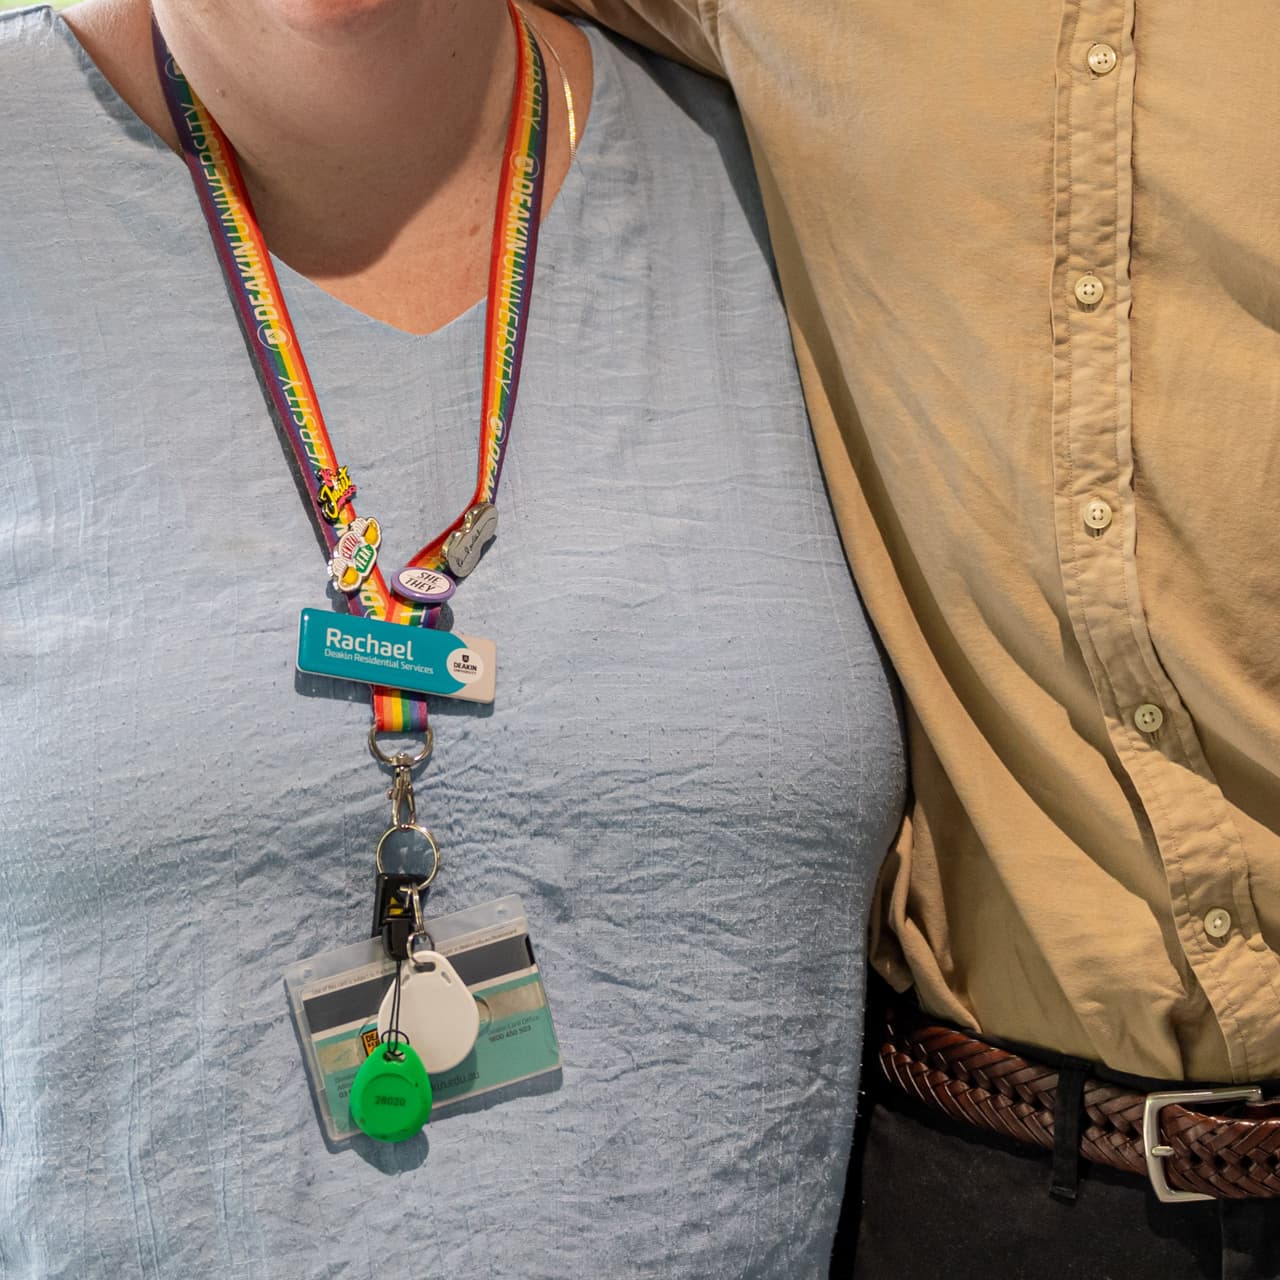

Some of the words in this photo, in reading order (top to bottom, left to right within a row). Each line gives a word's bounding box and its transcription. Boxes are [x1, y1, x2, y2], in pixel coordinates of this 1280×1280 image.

[180, 103, 250, 237] UNIVERSITY
[505, 174, 534, 255] DEAKIN
[230, 241, 279, 321] DEAKIN
[494, 255, 525, 395] UNIVERSITY
[405, 578, 436, 593] THEY
[325, 648, 353, 660] Deakin
[354, 653, 399, 669] Residential
[400, 661, 434, 674] Services
[326, 627, 414, 661] Rachael
[453, 662, 478, 671] DEAKIN
